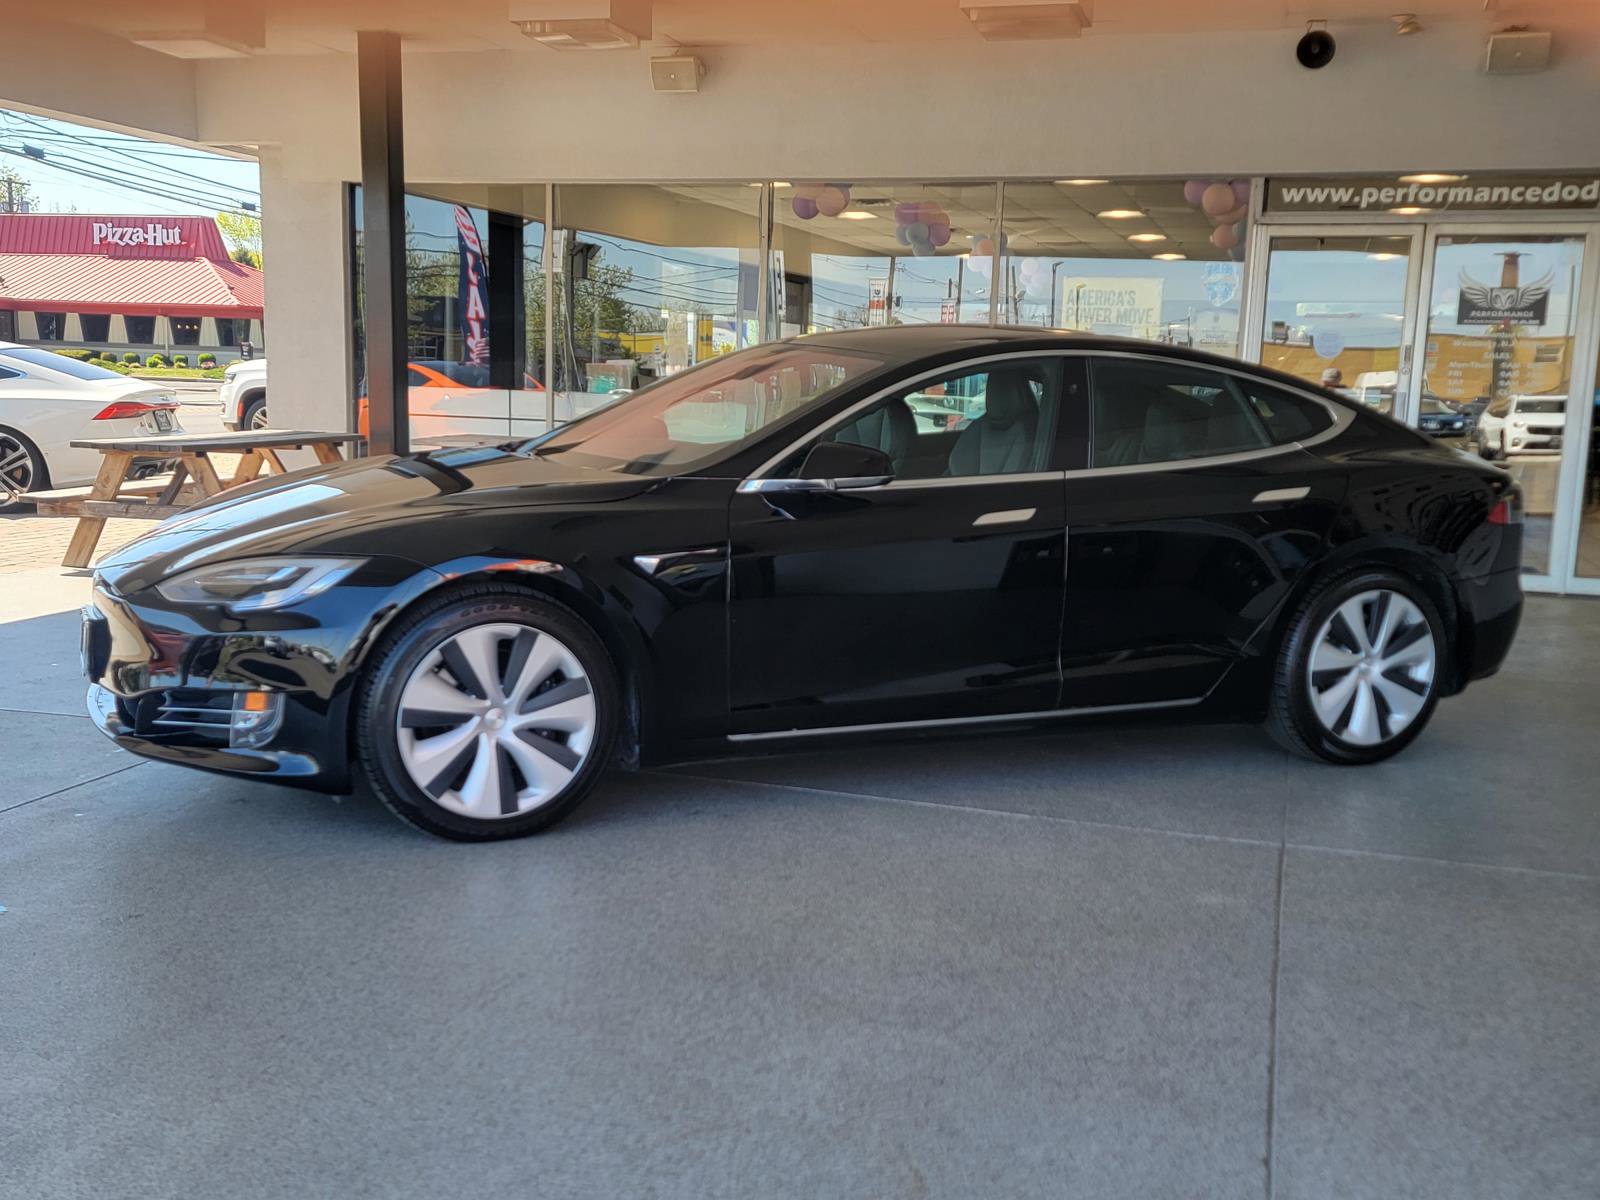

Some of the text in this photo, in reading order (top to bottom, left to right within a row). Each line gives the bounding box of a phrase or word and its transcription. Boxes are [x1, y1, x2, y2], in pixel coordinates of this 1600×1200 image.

[1281, 179, 1599, 208] www.performancedod
[92, 222, 182, 246] Pizza Hut
[1471, 310, 1535, 318] PERFORMANCE
